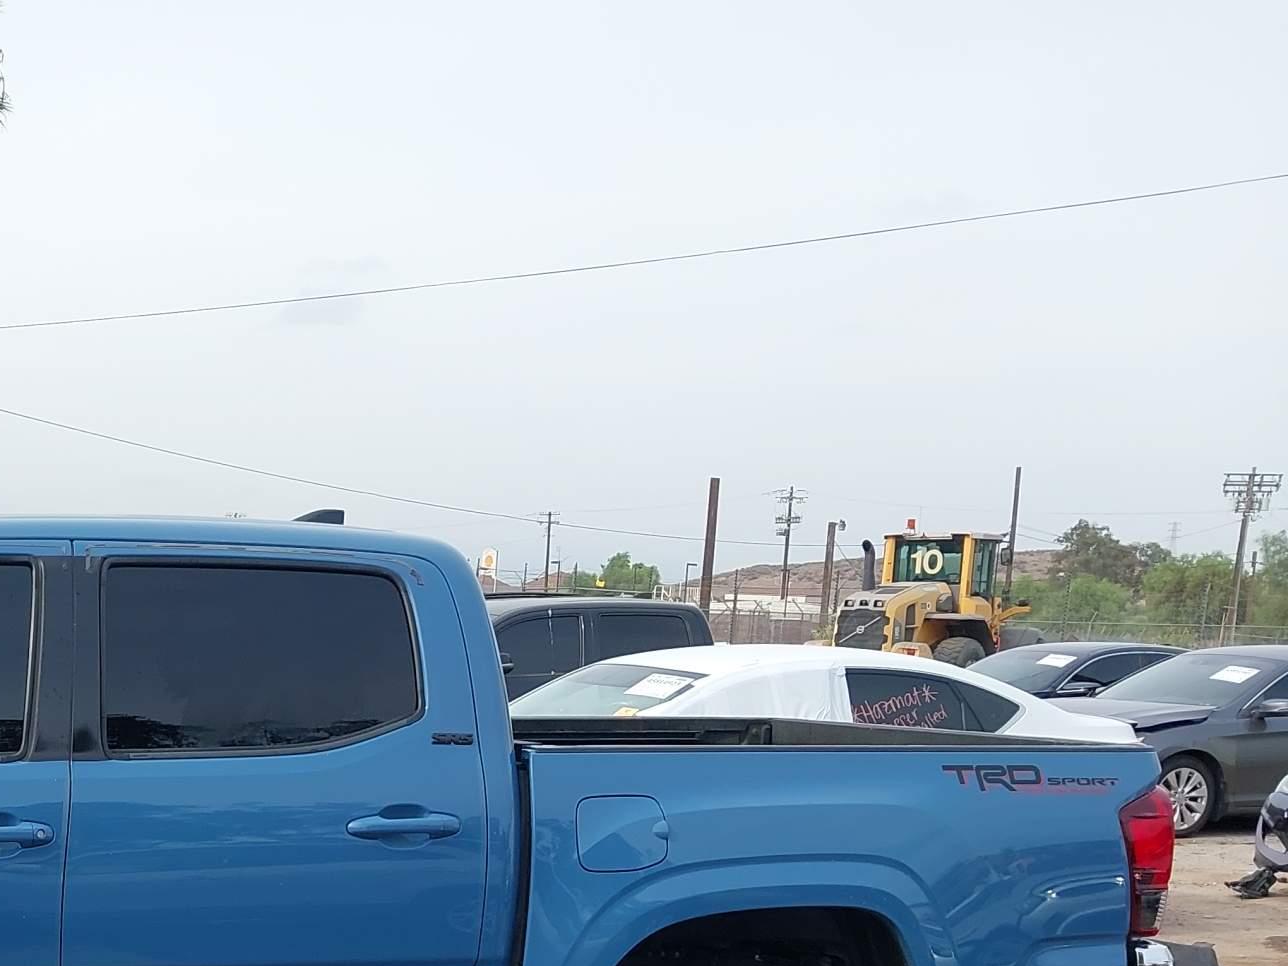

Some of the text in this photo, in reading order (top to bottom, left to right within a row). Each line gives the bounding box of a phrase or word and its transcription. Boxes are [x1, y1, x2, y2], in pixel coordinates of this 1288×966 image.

[911, 549, 943, 575] 10
[942, 765, 1119, 791] TRD SPORT
